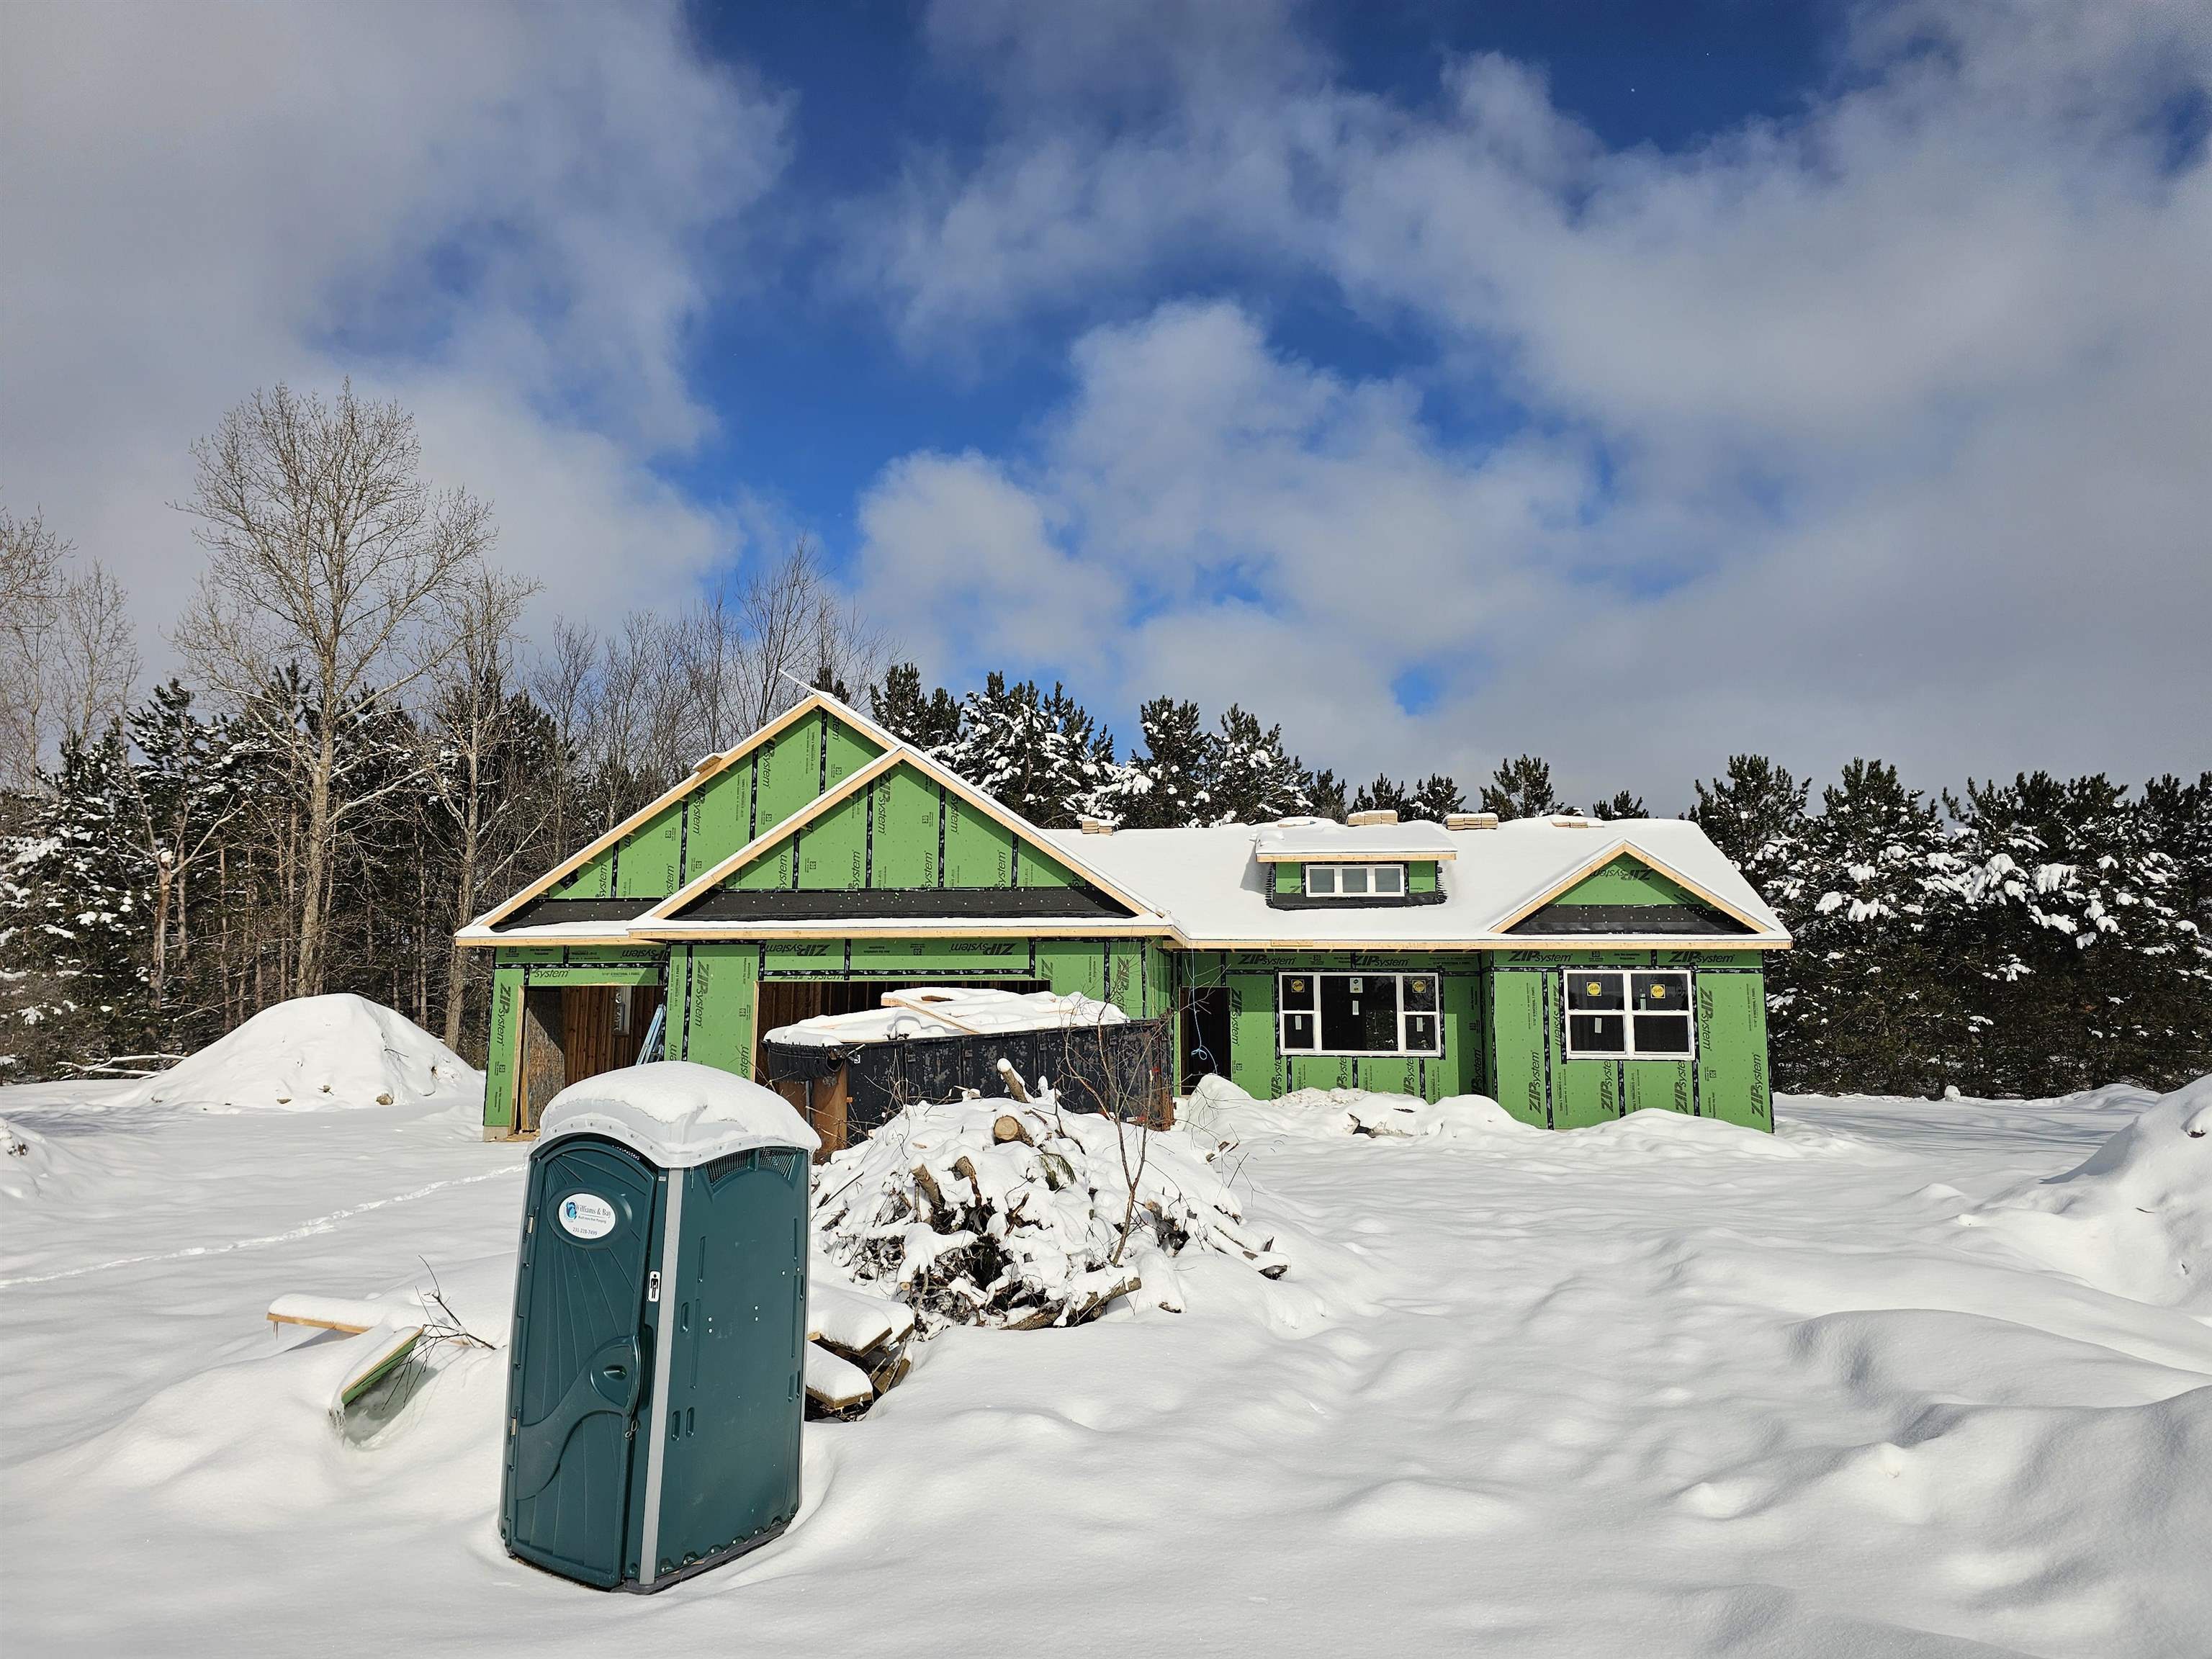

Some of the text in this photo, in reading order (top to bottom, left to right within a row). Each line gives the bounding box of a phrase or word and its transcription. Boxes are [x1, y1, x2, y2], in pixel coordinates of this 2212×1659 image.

[878, 773, 891, 834] ZIPsystem
[766, 944, 830, 956] ZIPsystem
[950, 943, 1017, 956] ZIPsystem
[1238, 954, 1295, 965] ZIPsystem
[1355, 956, 1408, 966] ZIPsystem
[1508, 950, 1571, 962] ZIPsystem
[1668, 951, 1734, 963] ZIPsystem
[497, 983, 511, 1044] ZIPsystem
[695, 961, 709, 1028] ZIPsystem
[1232, 987, 1242, 1045] ZIPsystem
[1700, 987, 1713, 1050] ZIPsystem
[1529, 1052, 1541, 1114] ZIPsystem
[1750, 1053, 1764, 1118] ZIPsystem
